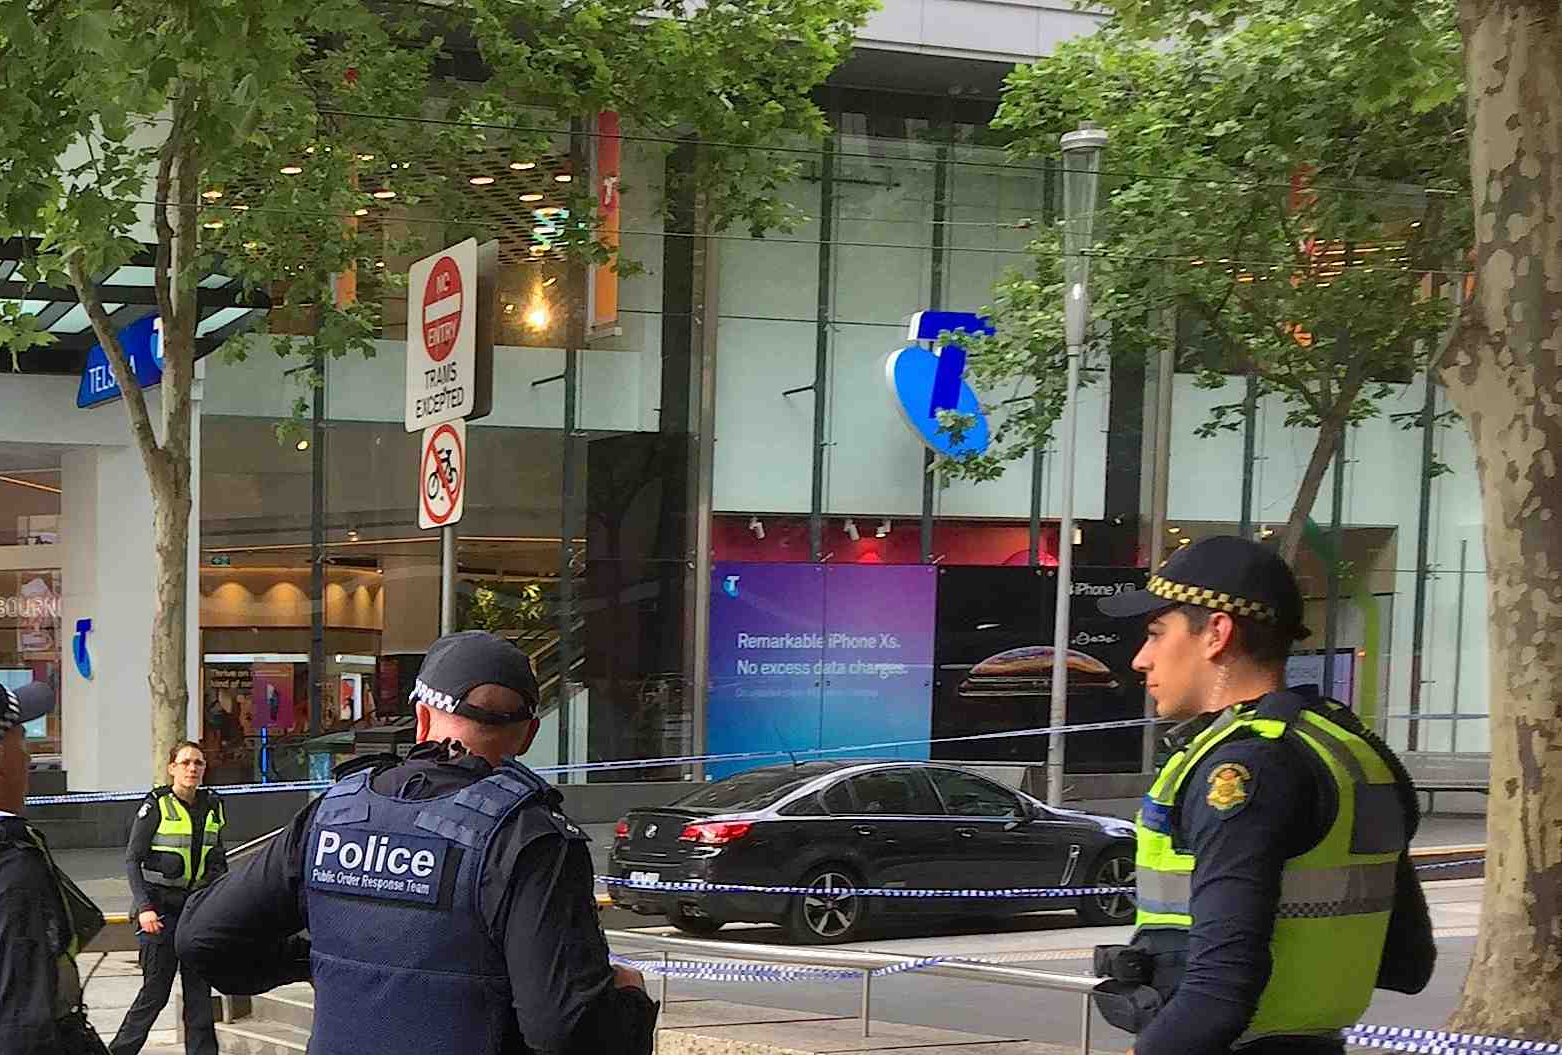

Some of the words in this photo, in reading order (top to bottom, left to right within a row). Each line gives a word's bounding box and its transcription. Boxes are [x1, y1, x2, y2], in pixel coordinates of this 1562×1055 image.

[427, 321, 456, 348] ENTRY
[424, 361, 457, 390] TRAMS
[415, 386, 465, 419] EXCEPTED
[738, 633, 824, 649] Remarkable
[828, 633, 878, 649] iPhone
[737, 660, 758, 675] No
[760, 663, 811, 675] excess
[813, 660, 847, 675] data
[849, 660, 908, 679] charges.
[315, 830, 435, 877] Police
[312, 869, 336, 884] Public
[337, 872, 360, 887] Order
[361, 874, 405, 892] Response
[406, 880, 430, 895] Team
